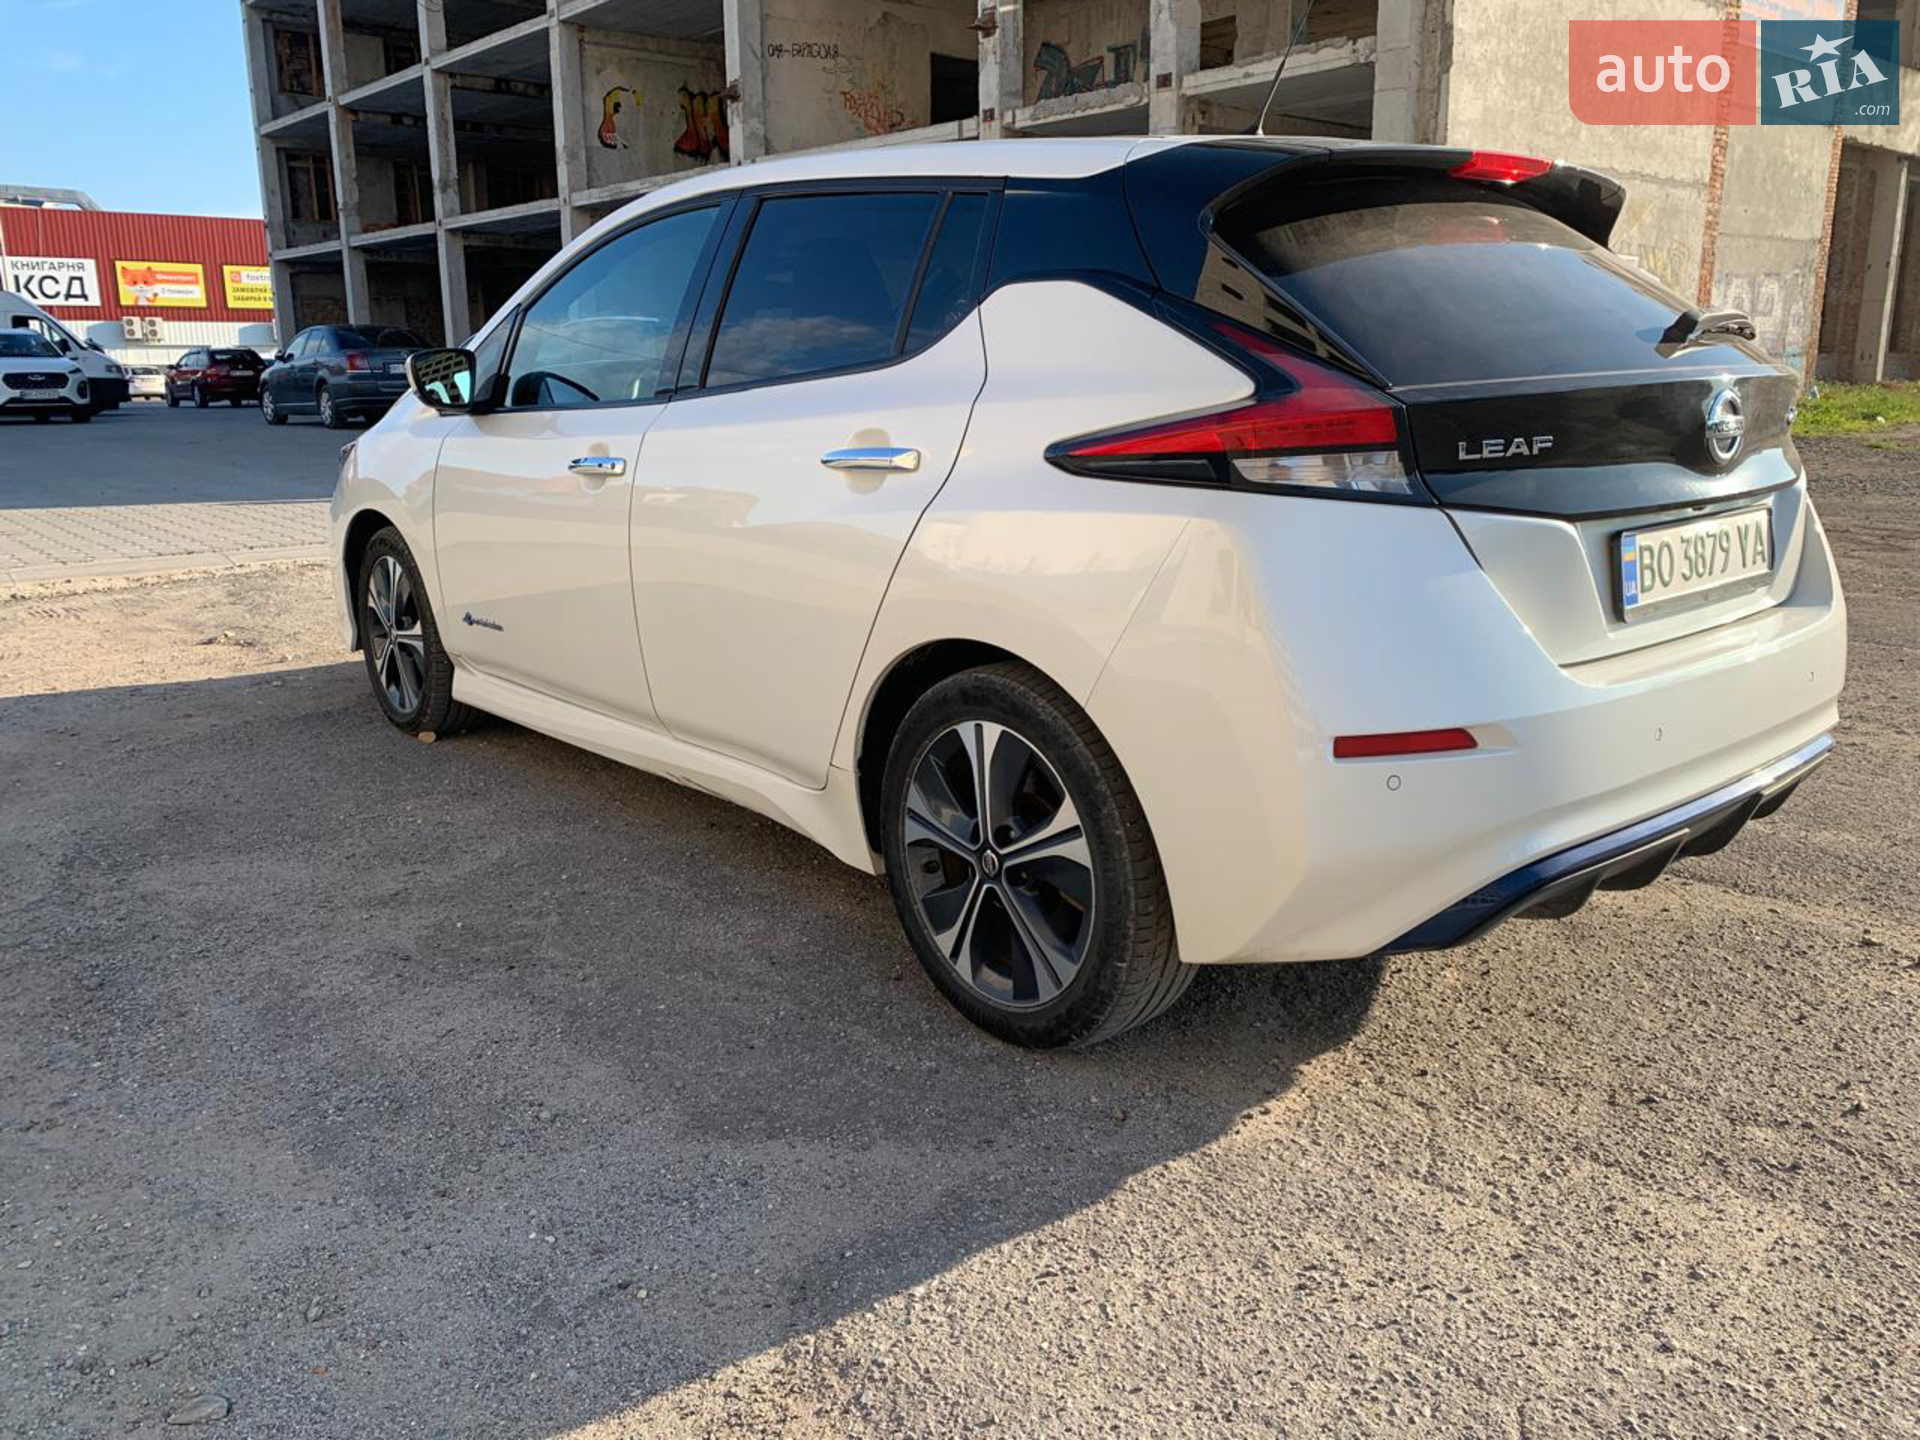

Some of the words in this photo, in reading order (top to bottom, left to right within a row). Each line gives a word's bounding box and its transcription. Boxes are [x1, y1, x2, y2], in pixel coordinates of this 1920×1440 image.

[11, 260, 85, 272] КНИГАРНЯ
[13, 274, 89, 302] КСД
[1458, 436, 1554, 460] LEAF
[1639, 540, 1674, 594] BO
[1681, 528, 1731, 582] 3879
